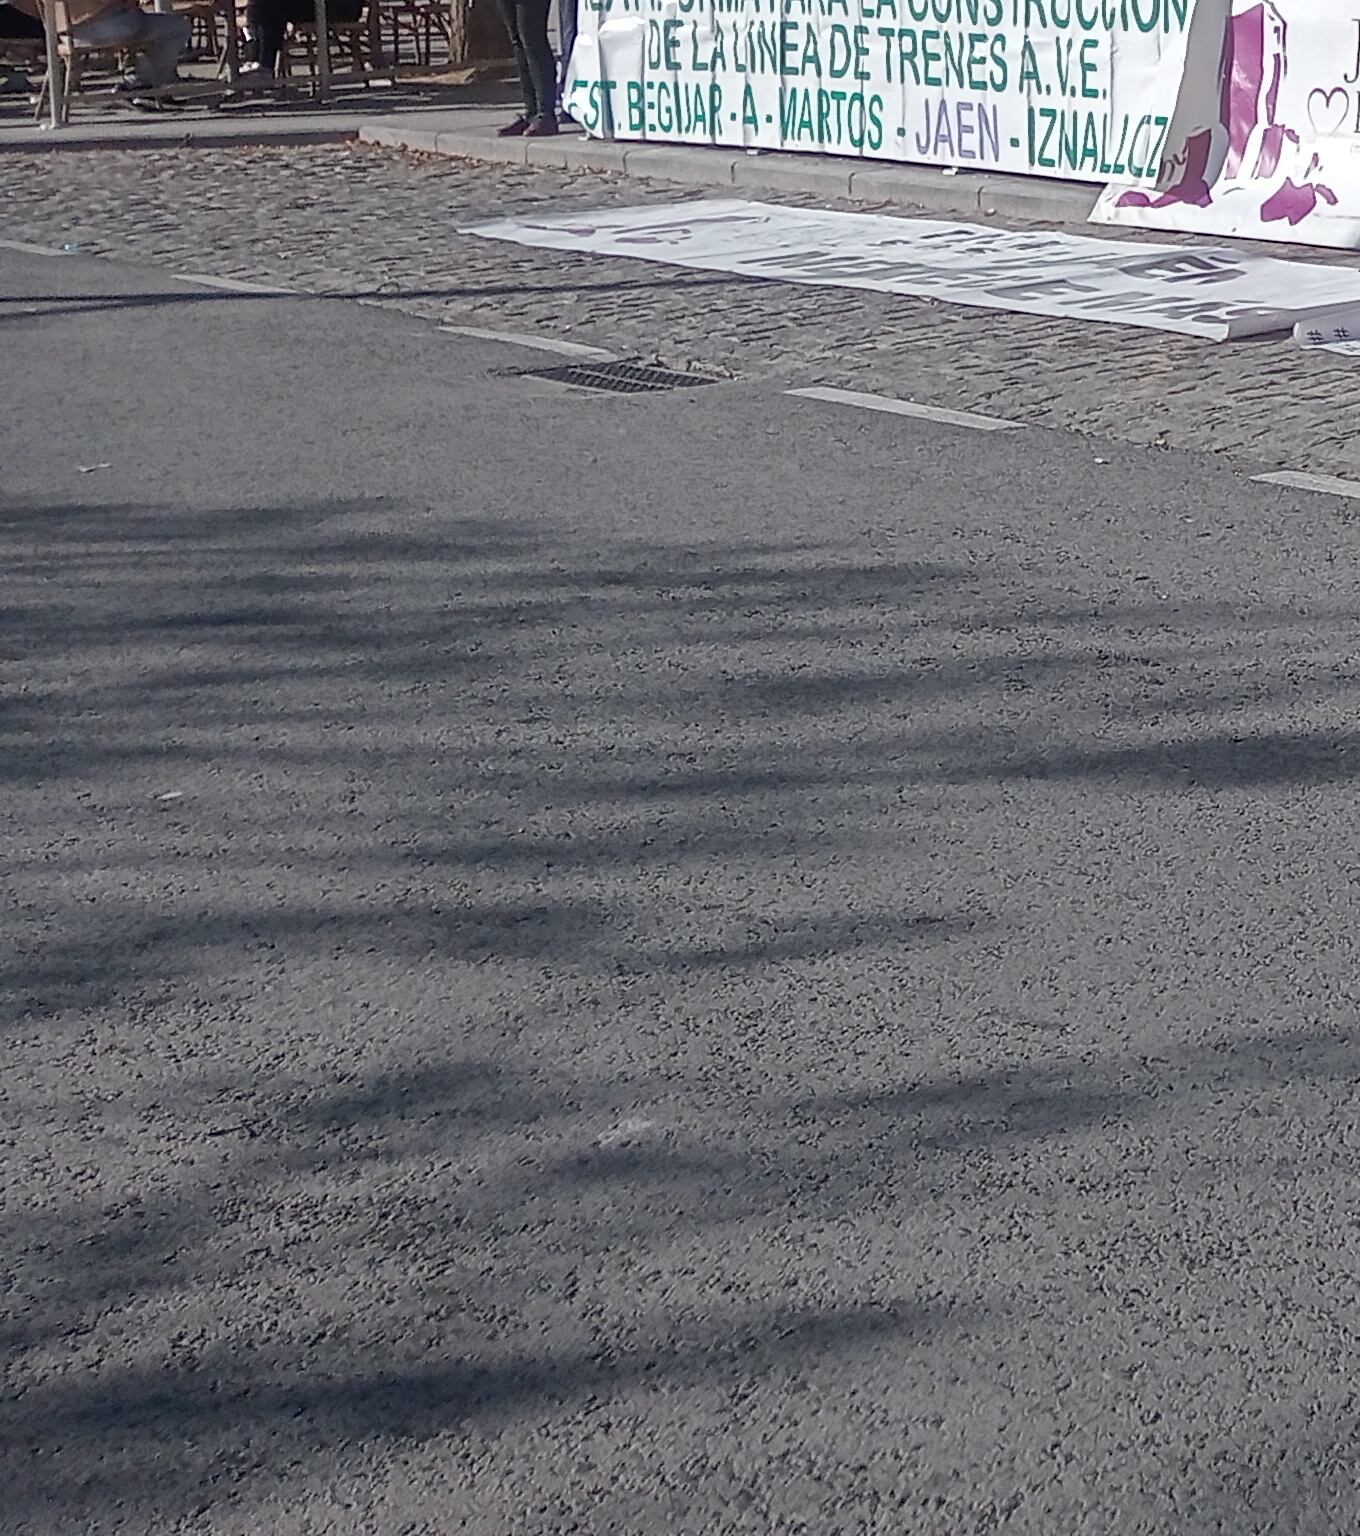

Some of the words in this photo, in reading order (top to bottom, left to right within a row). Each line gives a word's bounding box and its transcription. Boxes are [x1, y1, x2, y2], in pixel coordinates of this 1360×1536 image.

[649, 19, 685, 71] DE
[691, 19, 727, 73] LA
[830, 23, 871, 81] DE
[878, 27, 1008, 93] TRENES
[1019, 35, 1108, 100] A.V.E.
[779, 86, 884, 151] MARTOS
[916, 98, 1000, 162] JAEN
